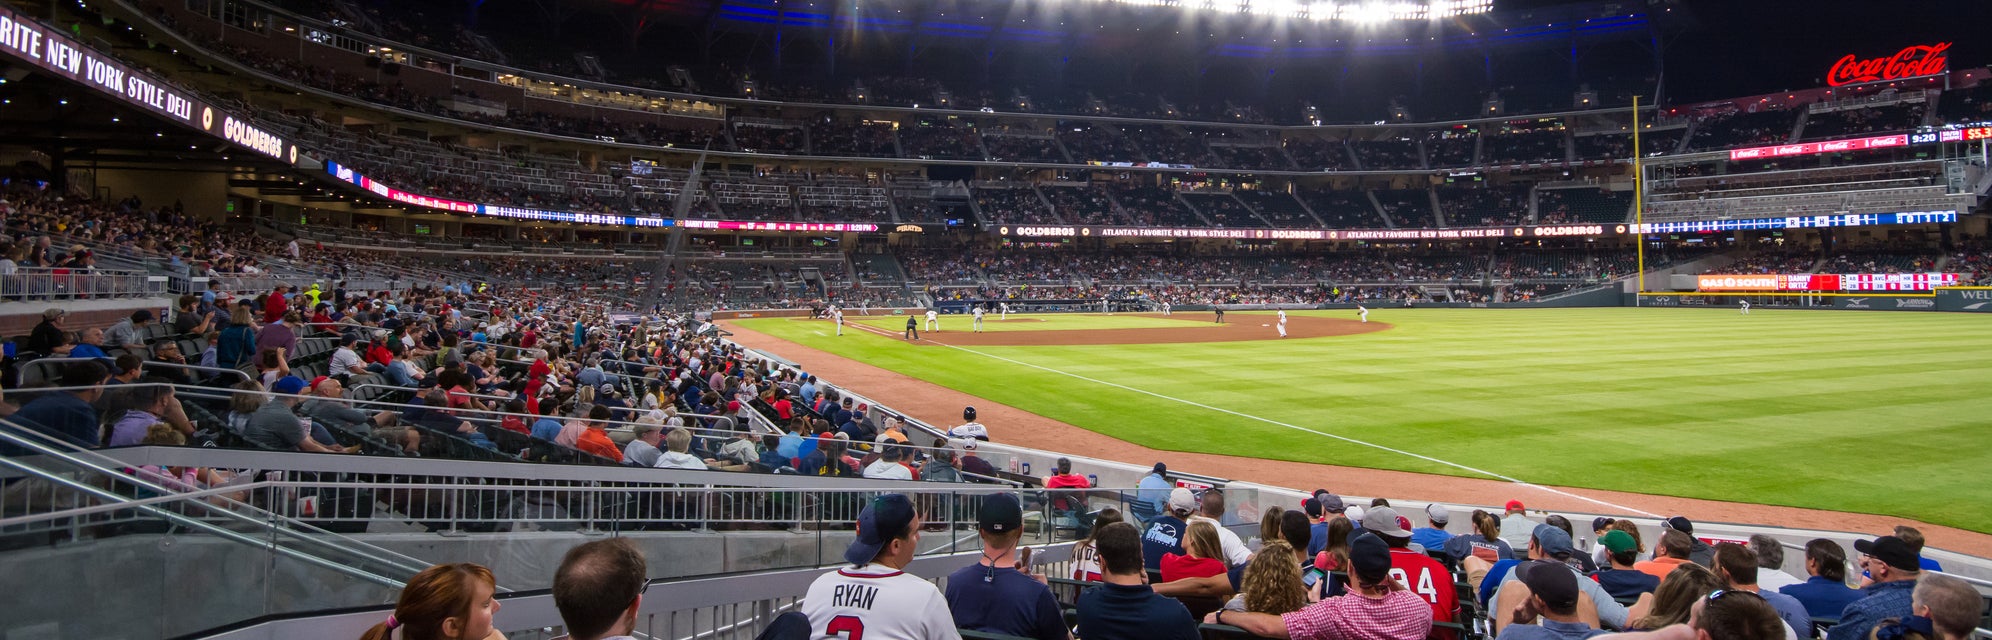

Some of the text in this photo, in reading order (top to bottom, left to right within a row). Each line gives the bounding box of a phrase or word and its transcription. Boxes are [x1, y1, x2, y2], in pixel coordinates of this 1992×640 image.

[0, 16, 191, 120] RITE NEW YORK STYLE DELI
[1827, 42, 1952, 86] Coca-Cola
[224, 116, 282, 158] GOLDBERGS
[1871, 137, 1897, 146] Coca-Cola
[1912, 134, 1936, 143] 9:20
[1780, 146, 1802, 154] Coca-Cola
[1824, 142, 1848, 150] Coca-Cola
[1737, 150, 1759, 158] Coca-Cola
[703, 220, 718, 228] ORTIZ
[1017, 227, 1075, 236] GOLDBERGS
[1534, 225, 1602, 236] GOLDBERGS
[1701, 278, 1775, 287] GAS SOUTH
[1961, 290, 1992, 299] WEL
[832, 584, 879, 611] RYAN
